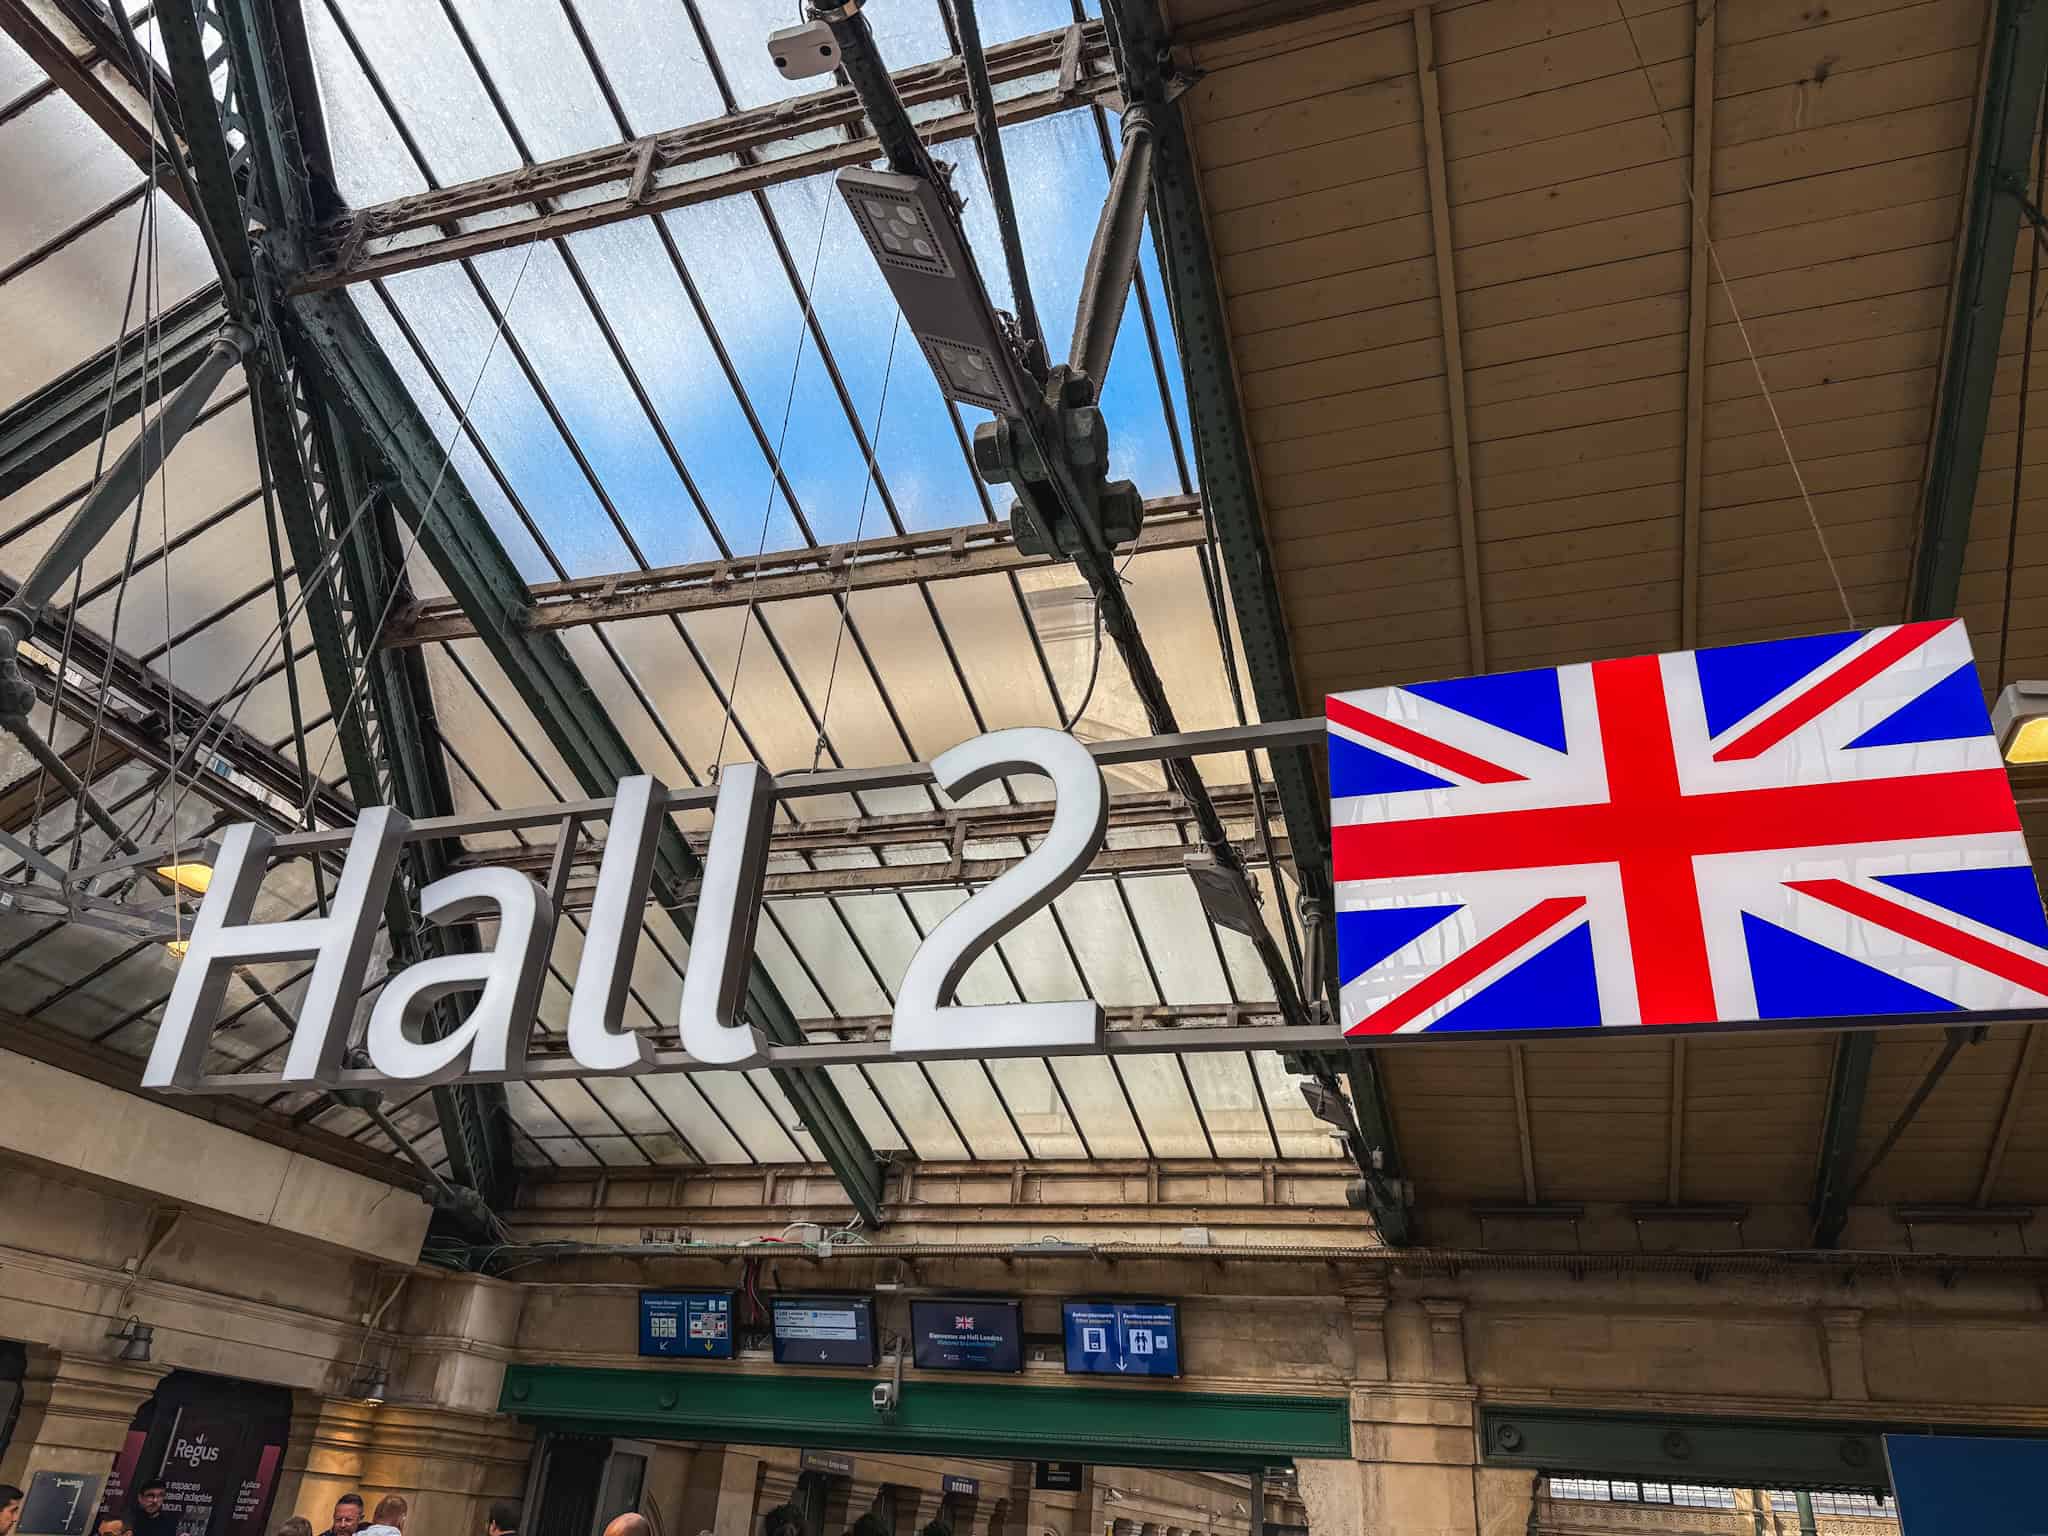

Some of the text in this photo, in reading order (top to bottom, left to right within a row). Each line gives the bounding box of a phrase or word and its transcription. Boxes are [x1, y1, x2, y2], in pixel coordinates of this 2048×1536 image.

[141, 727, 1102, 1088] Hall 2
[174, 1438, 220, 1468] Regus
